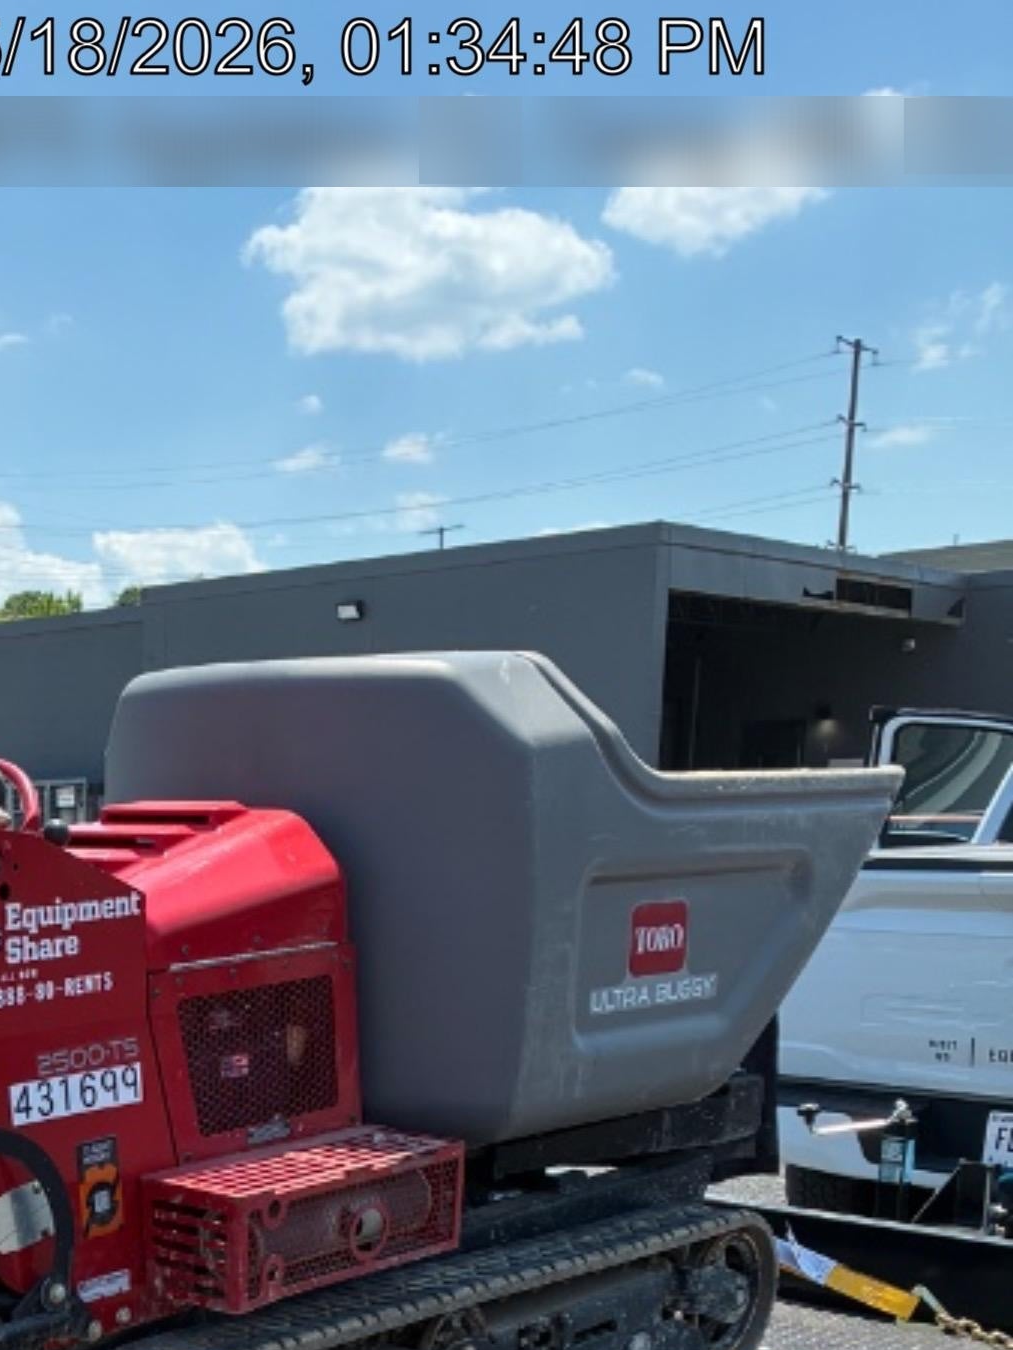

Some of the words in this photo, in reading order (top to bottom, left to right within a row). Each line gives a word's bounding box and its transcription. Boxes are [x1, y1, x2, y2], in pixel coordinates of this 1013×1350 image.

[4, 890, 141, 934] Equipment
[5, 934, 80, 965] Share
[634, 922, 685, 955] TORO
[590, 983, 651, 1014] ULTRA
[654, 972, 717, 1003] BUGGY
[14, 1065, 138, 1120] 431699
